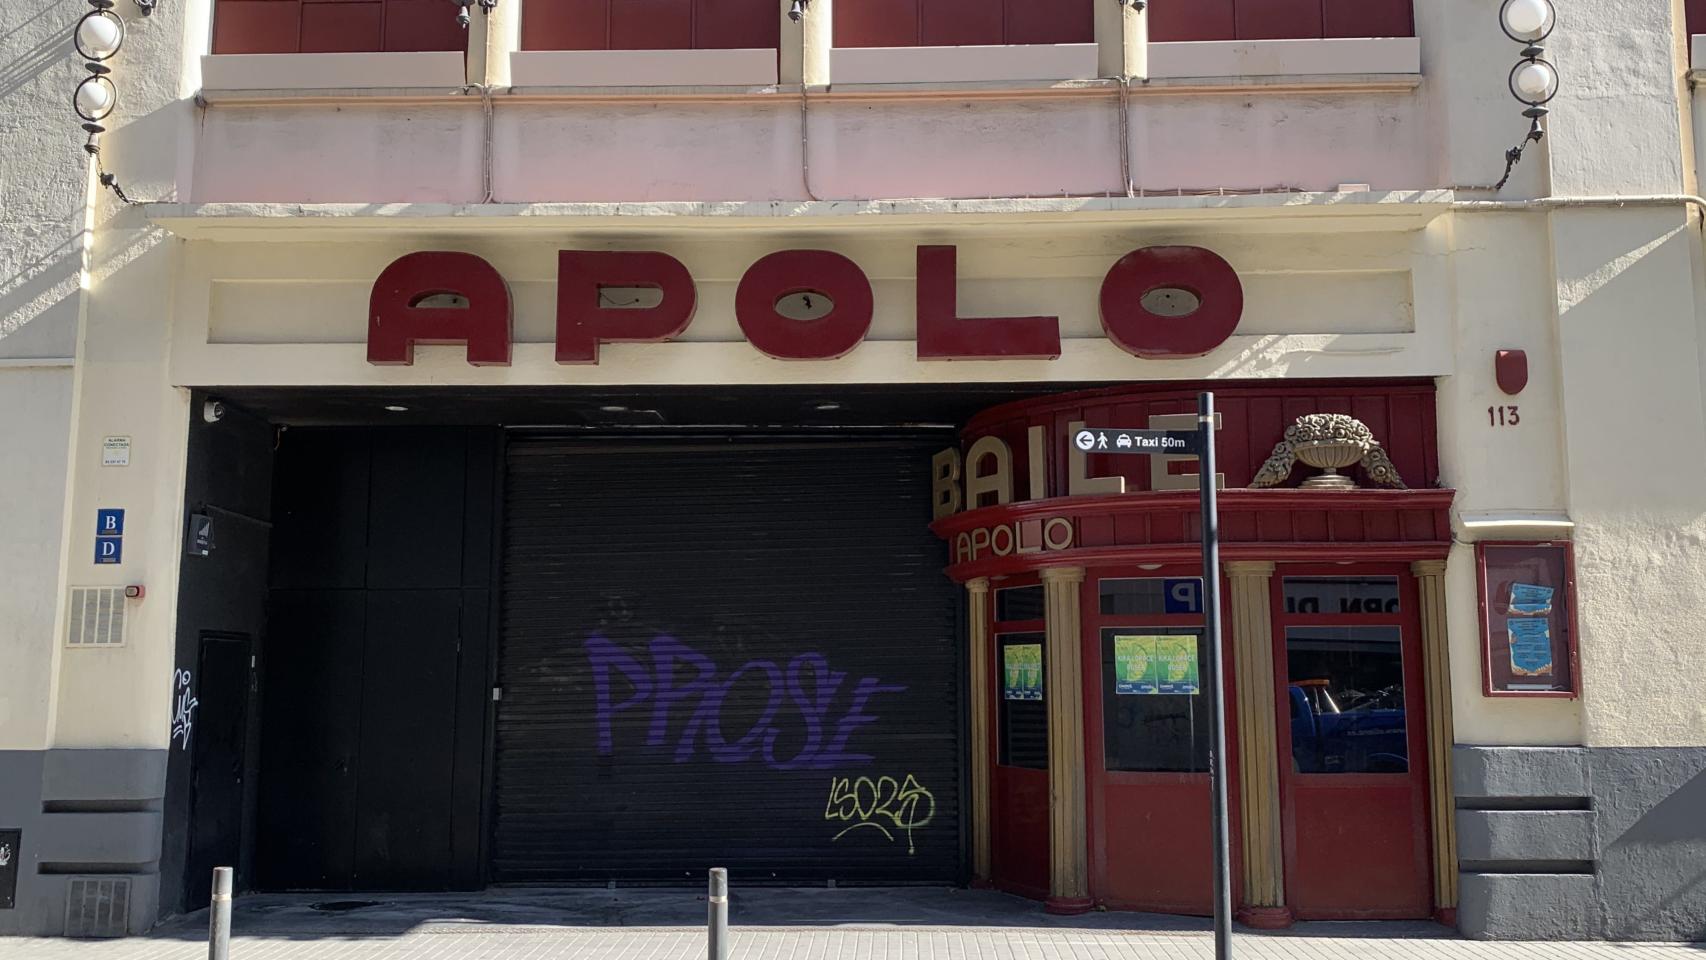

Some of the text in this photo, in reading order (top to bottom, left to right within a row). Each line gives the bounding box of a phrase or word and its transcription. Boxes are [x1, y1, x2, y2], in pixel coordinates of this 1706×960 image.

[367, 244, 1243, 365] APOLO
[1487, 405, 1520, 427] 113
[1134, 436, 1186, 449] Taxi 50m
[932, 412, 1225, 522] BAILE
[105, 515, 117, 530] B
[102, 541, 116, 556] D
[956, 516, 1074, 566] APOLO
